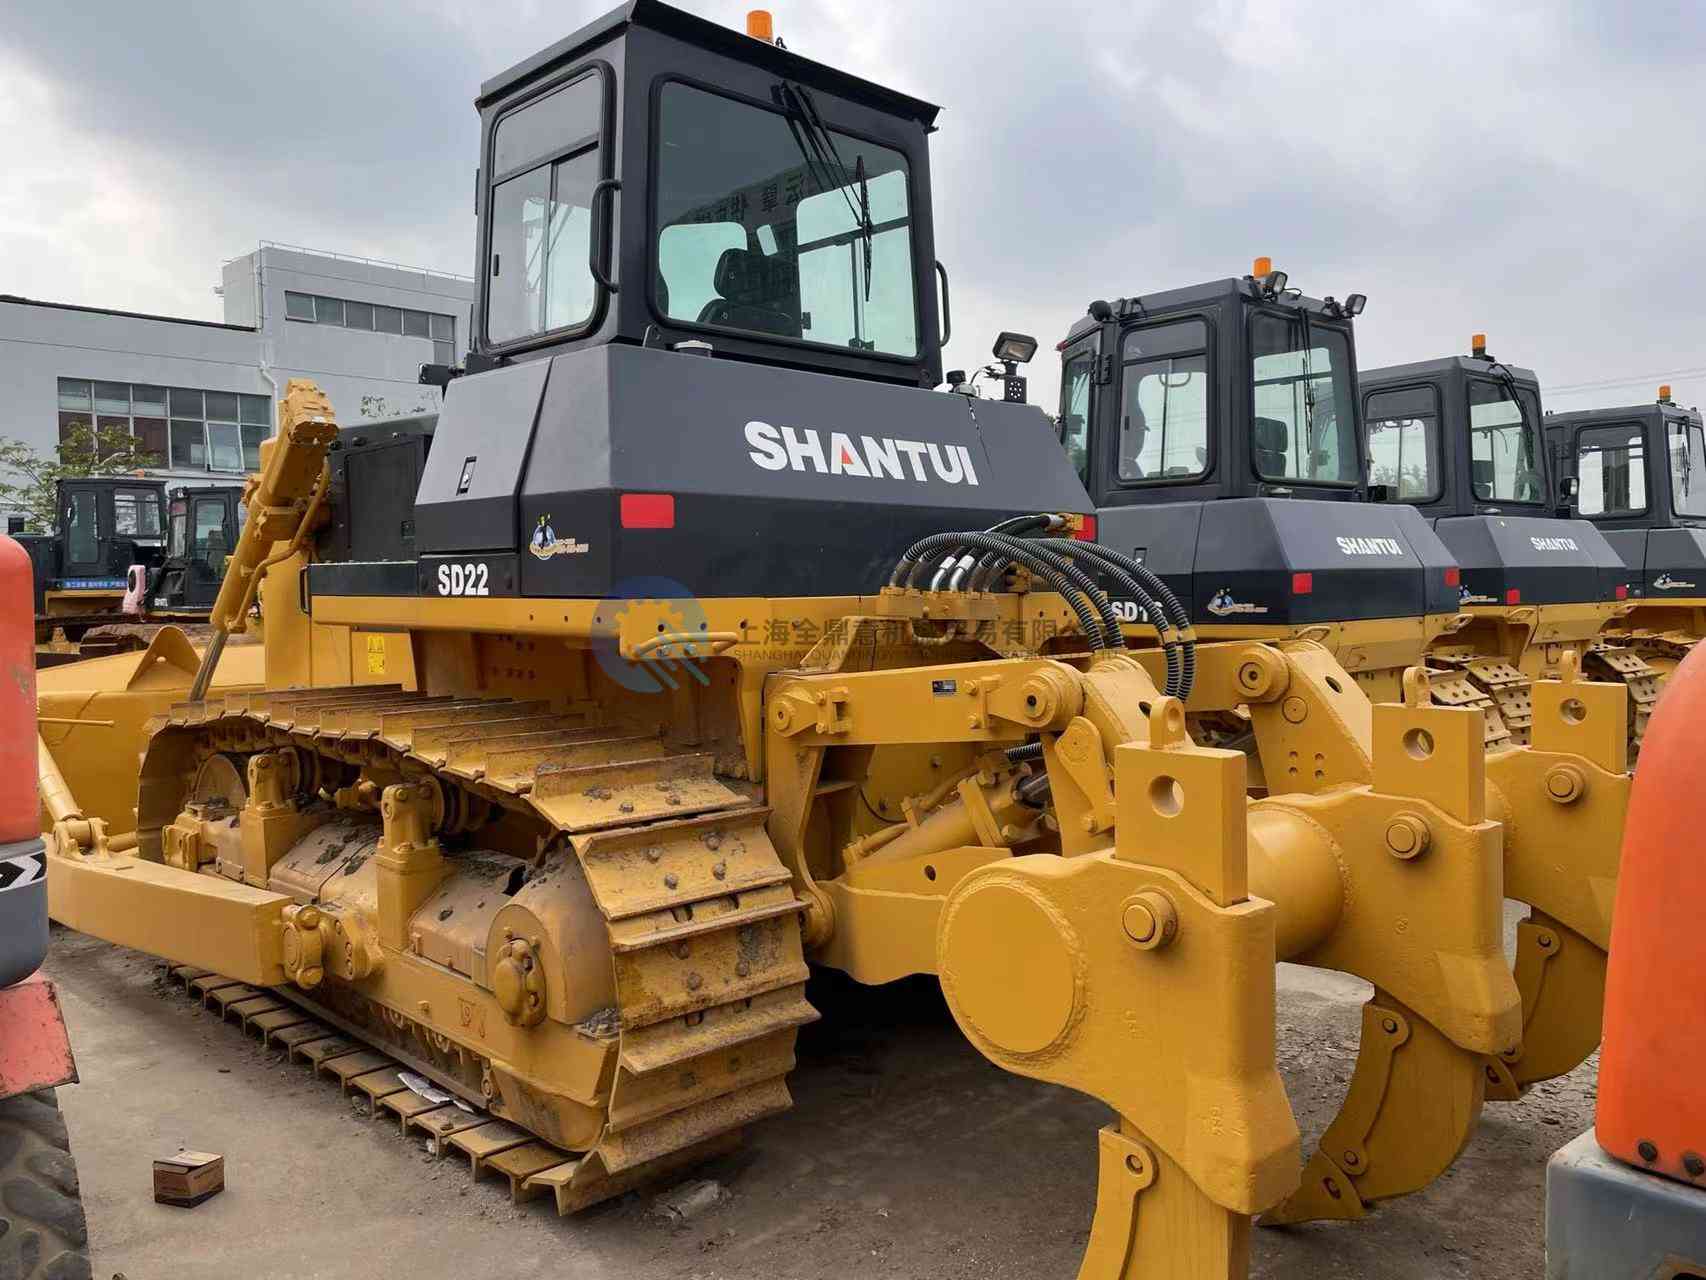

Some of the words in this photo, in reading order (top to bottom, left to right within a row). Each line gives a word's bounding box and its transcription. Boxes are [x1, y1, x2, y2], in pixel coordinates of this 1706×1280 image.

[744, 421, 979, 486] SHANTUI
[1336, 536, 1403, 555] SHANTUI
[1530, 536, 1579, 551] SHANTUI
[438, 563, 489, 596] SD22
